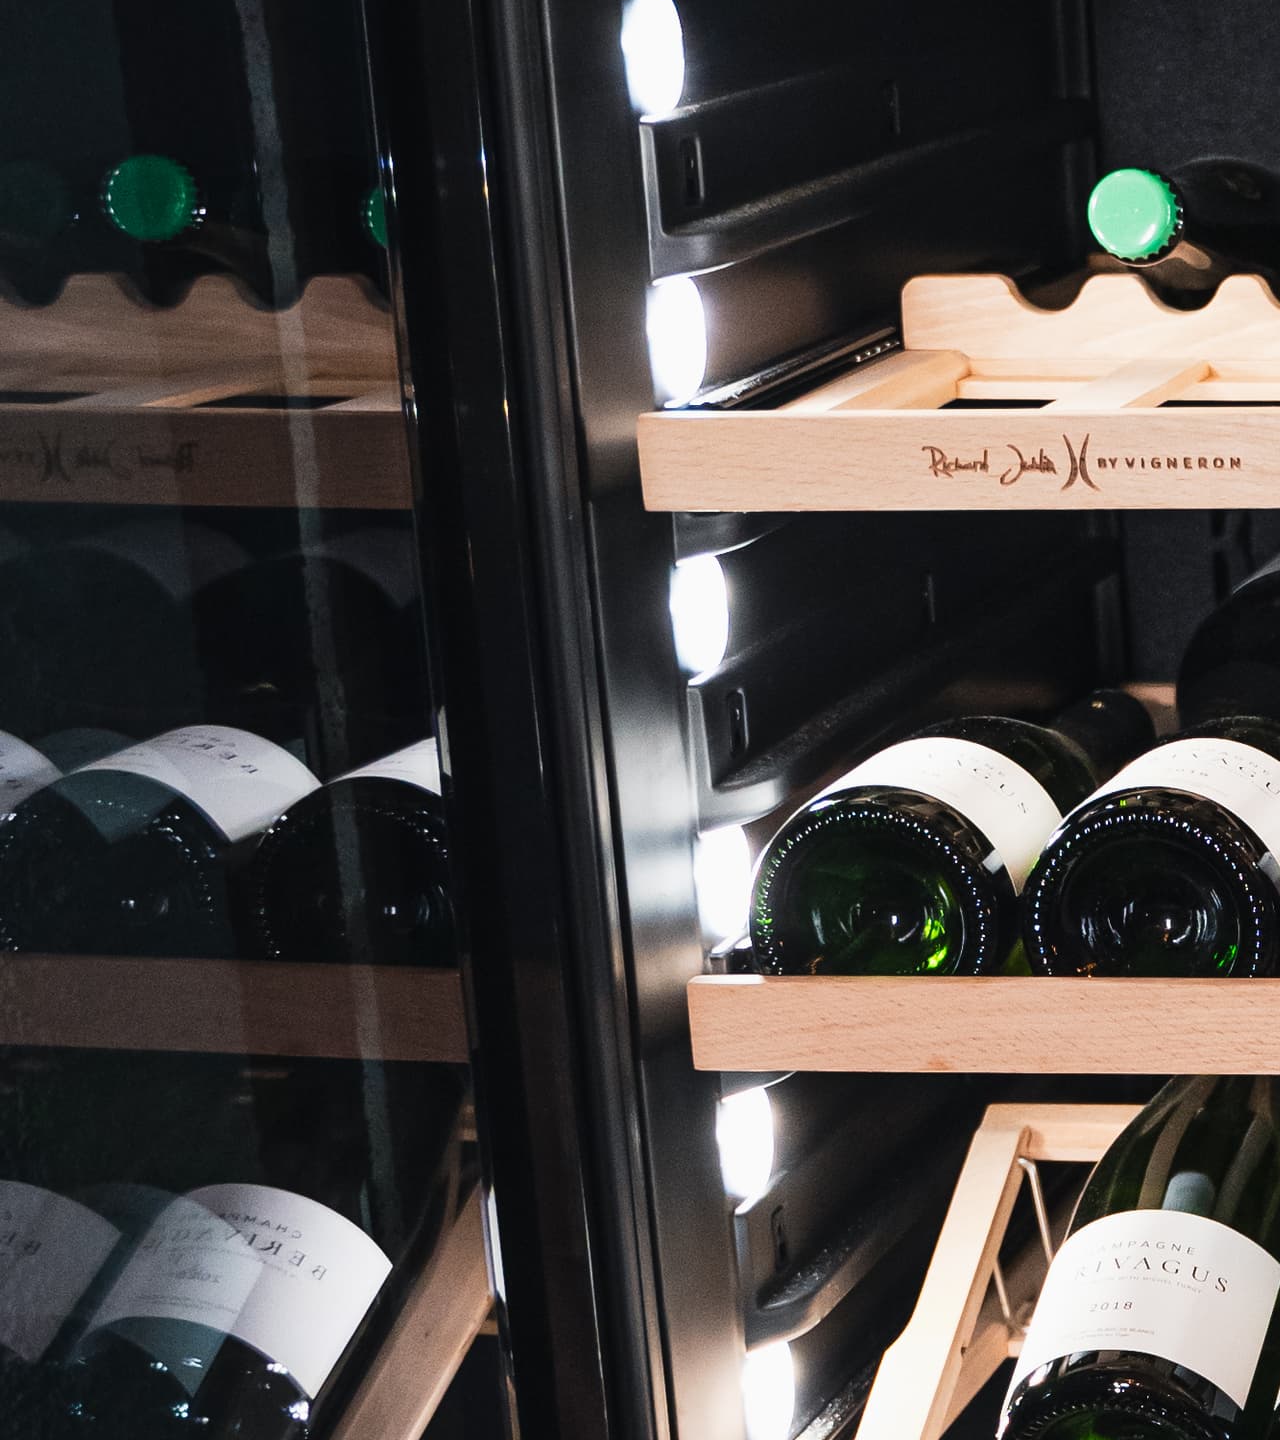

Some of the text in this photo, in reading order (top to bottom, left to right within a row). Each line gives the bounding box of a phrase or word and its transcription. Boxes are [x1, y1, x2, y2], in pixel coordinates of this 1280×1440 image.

[1096, 456, 1120, 470] BY
[1125, 456, 1244, 470] VIGNERON
[1074, 1256, 1230, 1294] RIVAGUS
[1089, 1300, 1135, 1313] 2018
